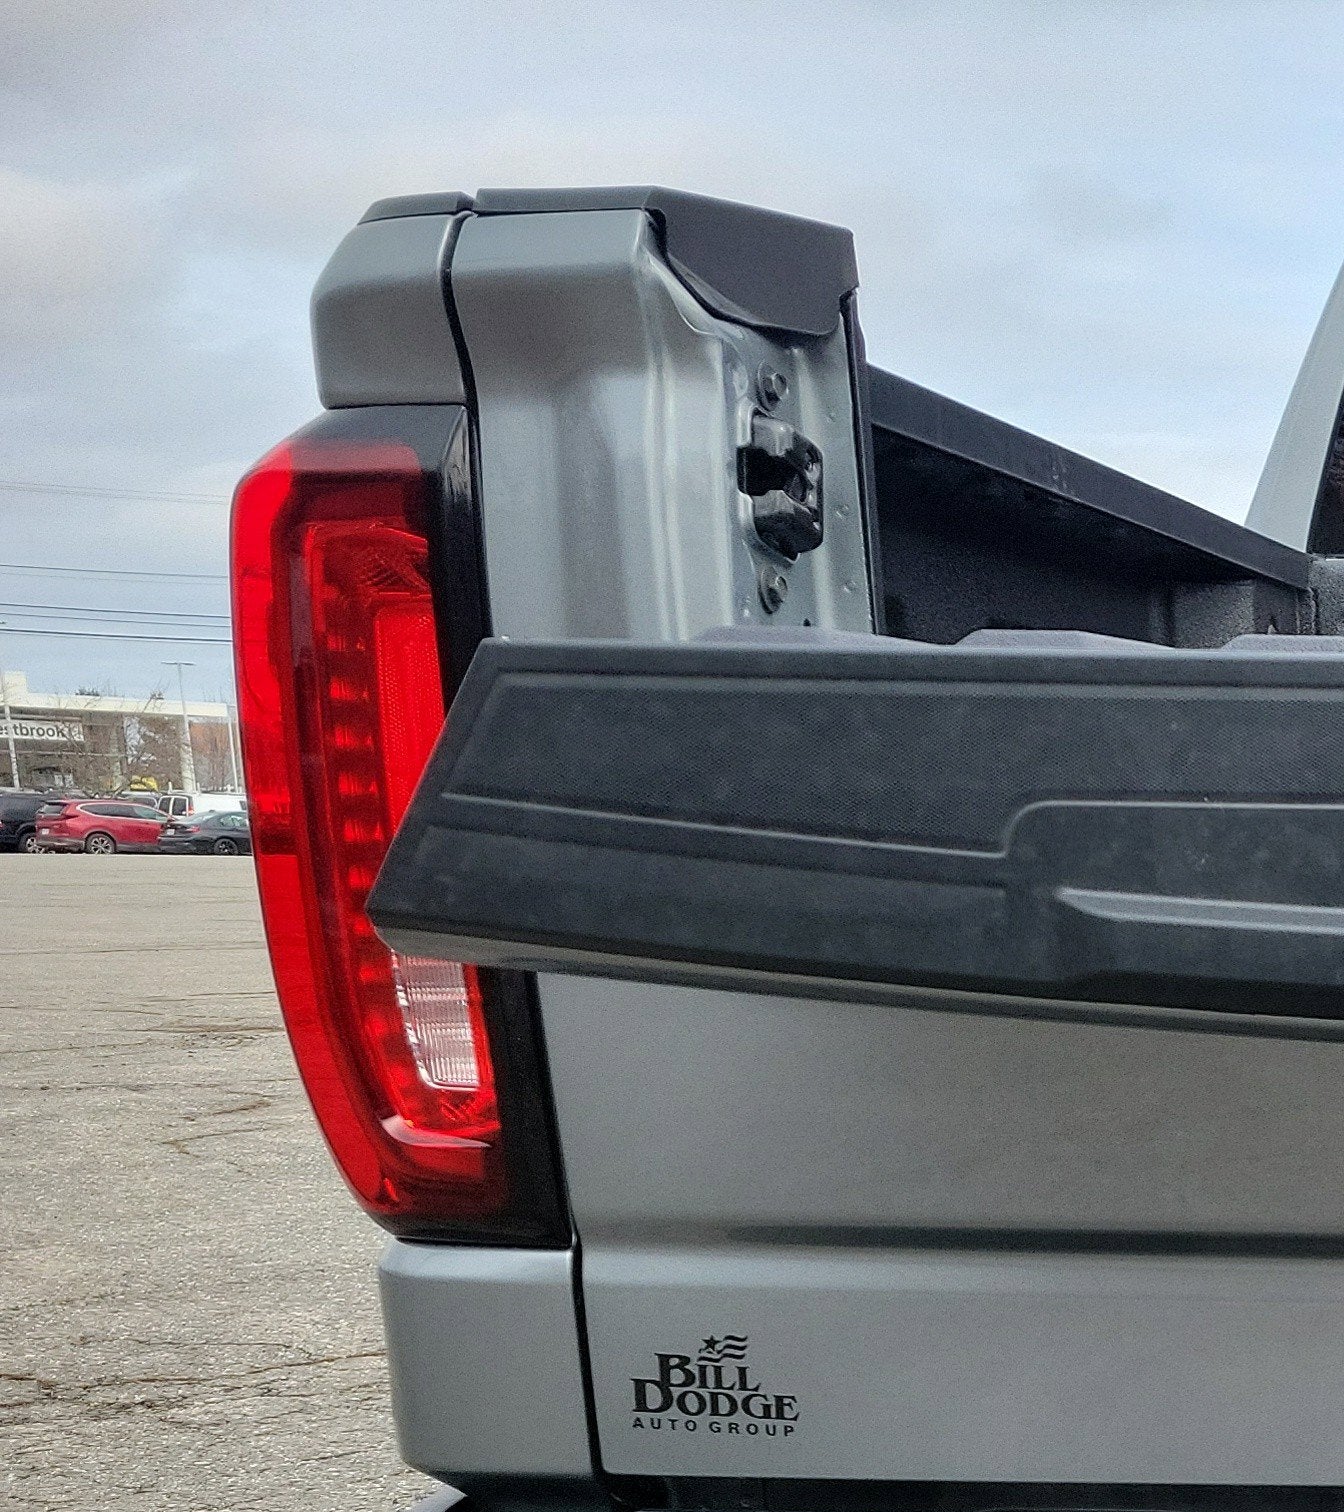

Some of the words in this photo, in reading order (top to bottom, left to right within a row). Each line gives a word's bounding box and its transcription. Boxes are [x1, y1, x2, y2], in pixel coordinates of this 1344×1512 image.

[654, 1352, 762, 1393] BILL
[630, 1378, 800, 1422] DODGE
[632, 1416, 698, 1432] AUTO
[708, 1420, 795, 1437] GROUP
